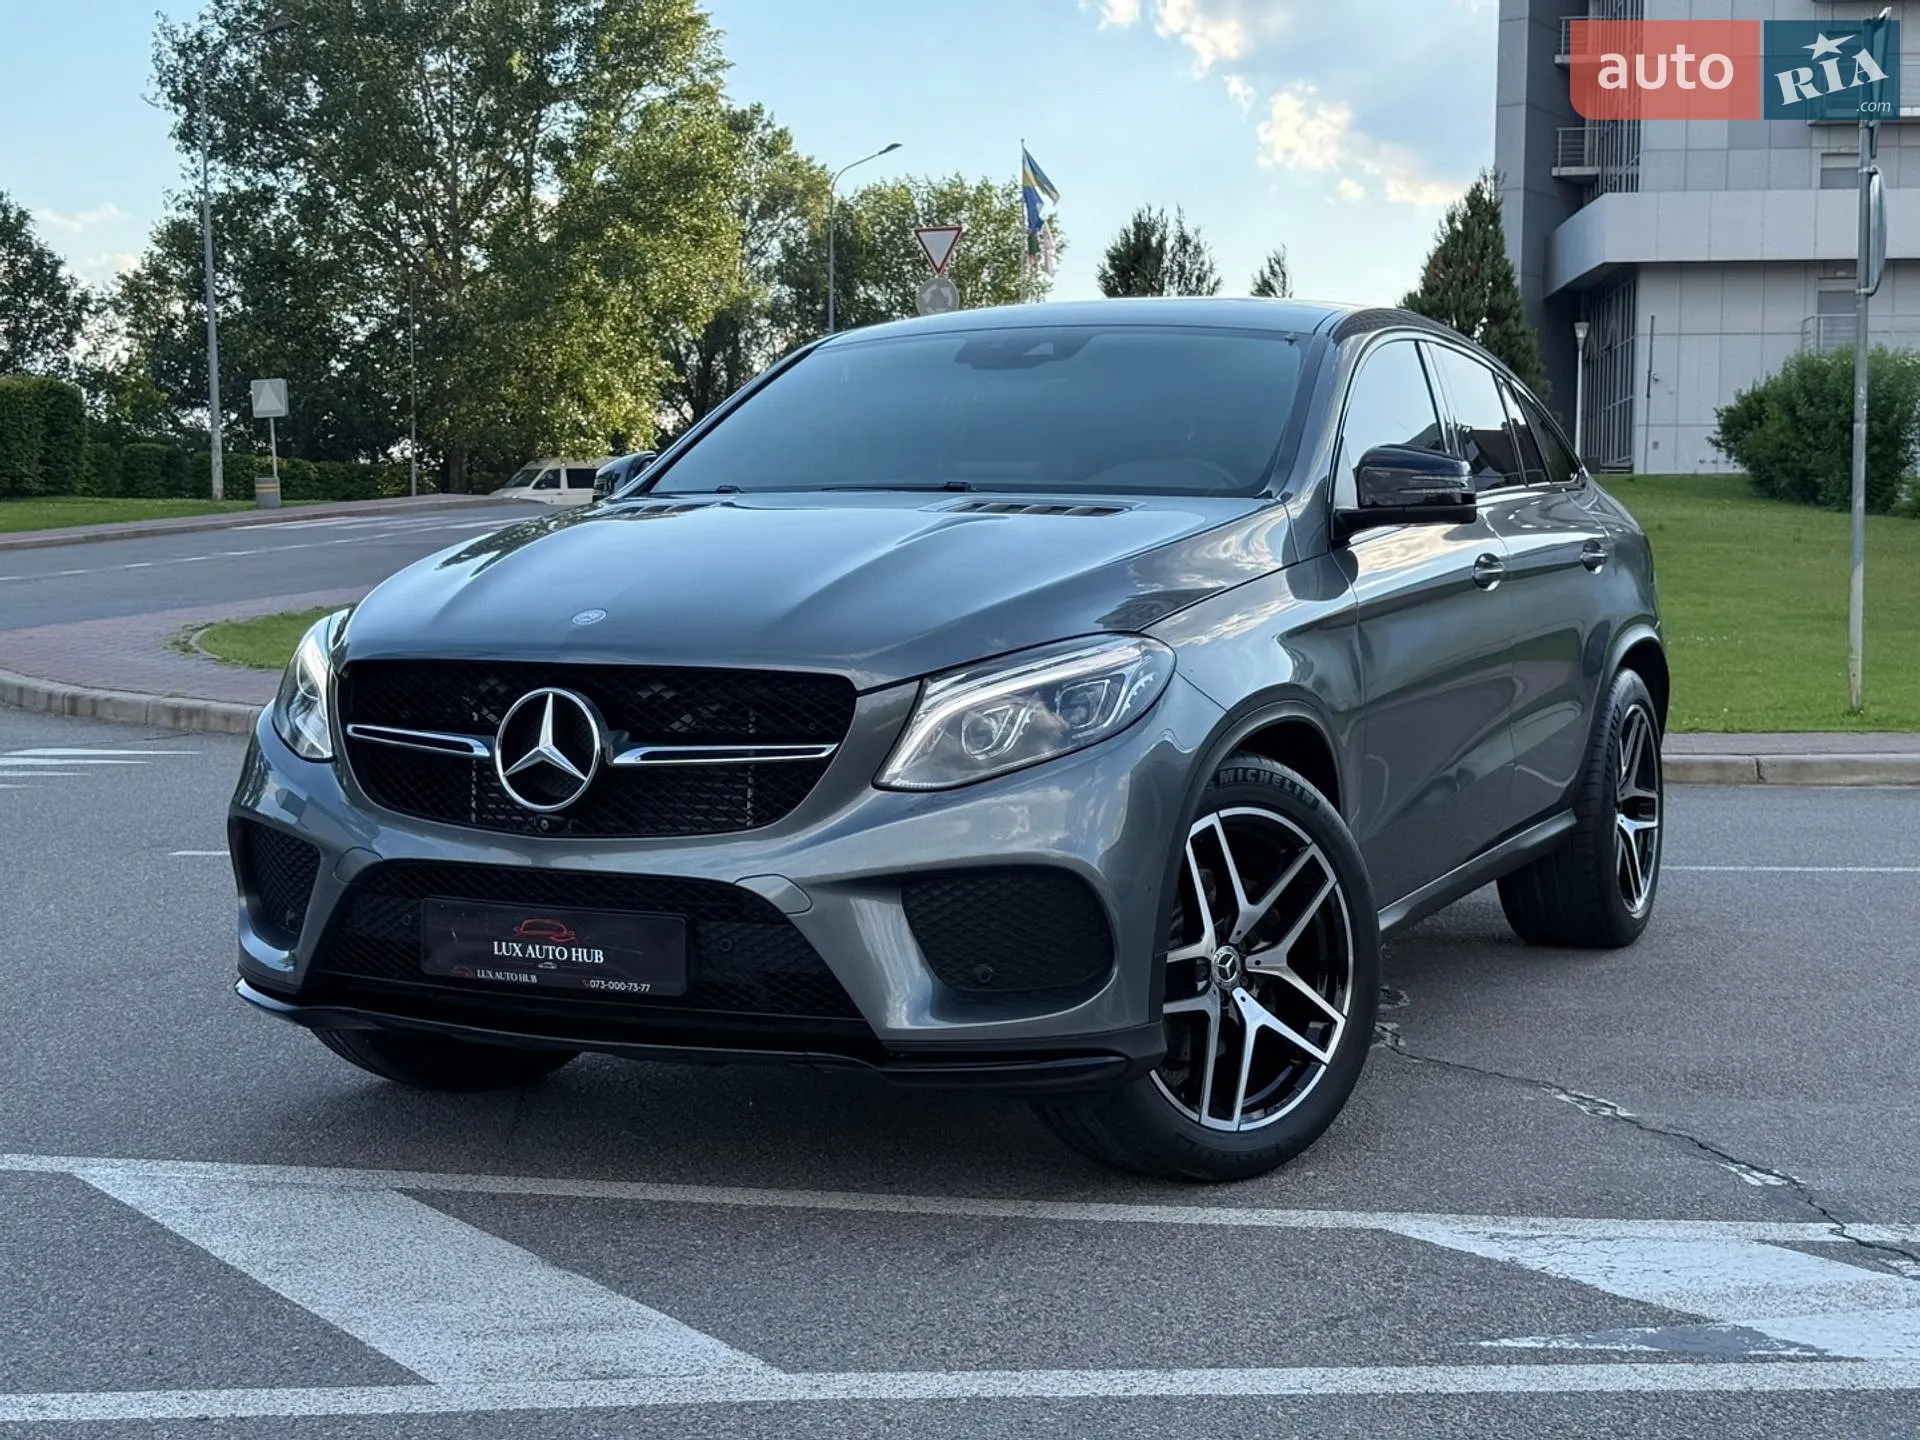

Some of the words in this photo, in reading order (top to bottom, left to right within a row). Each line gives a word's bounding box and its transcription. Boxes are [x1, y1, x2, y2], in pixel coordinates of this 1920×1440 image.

[1218, 768, 1317, 808] MICHELIN
[493, 941, 527, 958] LUX
[526, 945, 567, 961] AUTO
[571, 947, 604, 964] HUB
[476, 969, 495, 979] LUX
[494, 971, 518, 982] AUTO
[517, 973, 538, 984] HUB
[589, 979, 651, 992] 073-000-73-77
